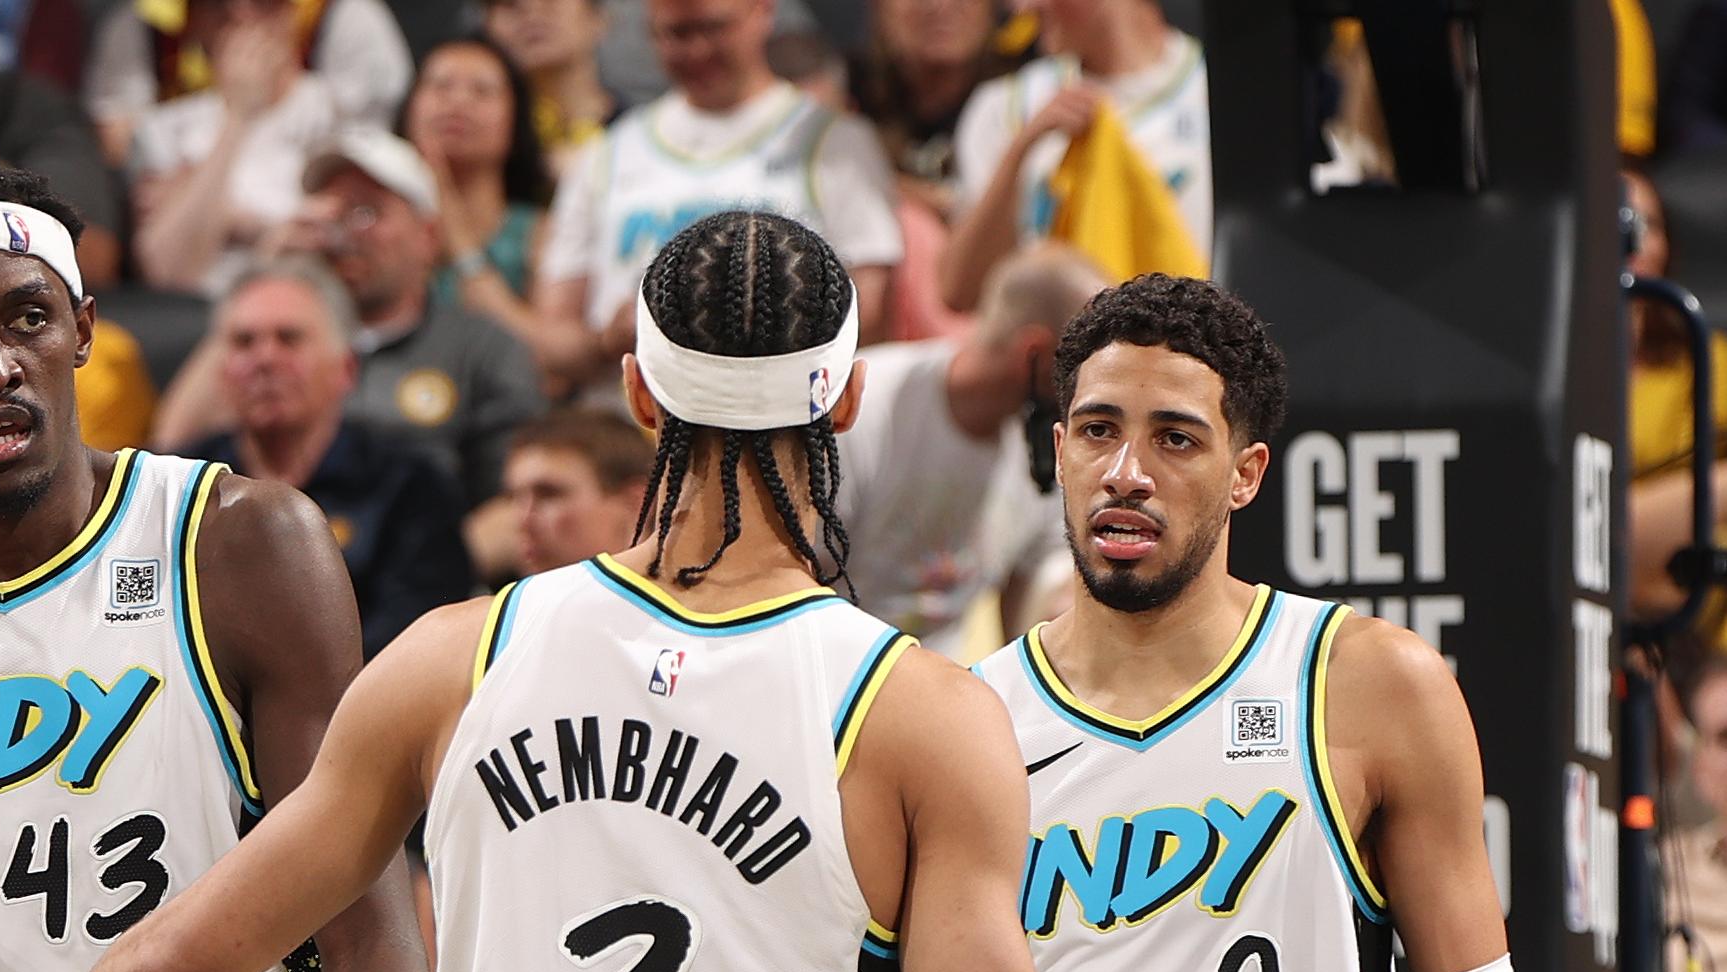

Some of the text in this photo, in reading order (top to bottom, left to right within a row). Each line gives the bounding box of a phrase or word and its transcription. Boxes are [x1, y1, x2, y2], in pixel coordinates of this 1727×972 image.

[1283, 429, 1460, 588] GET
[104, 608, 166, 624] spokenote
[475, 715, 812, 885] NEMBHARD
[1226, 747, 1289, 760] spokenote
[0, 812, 170, 942] 43
